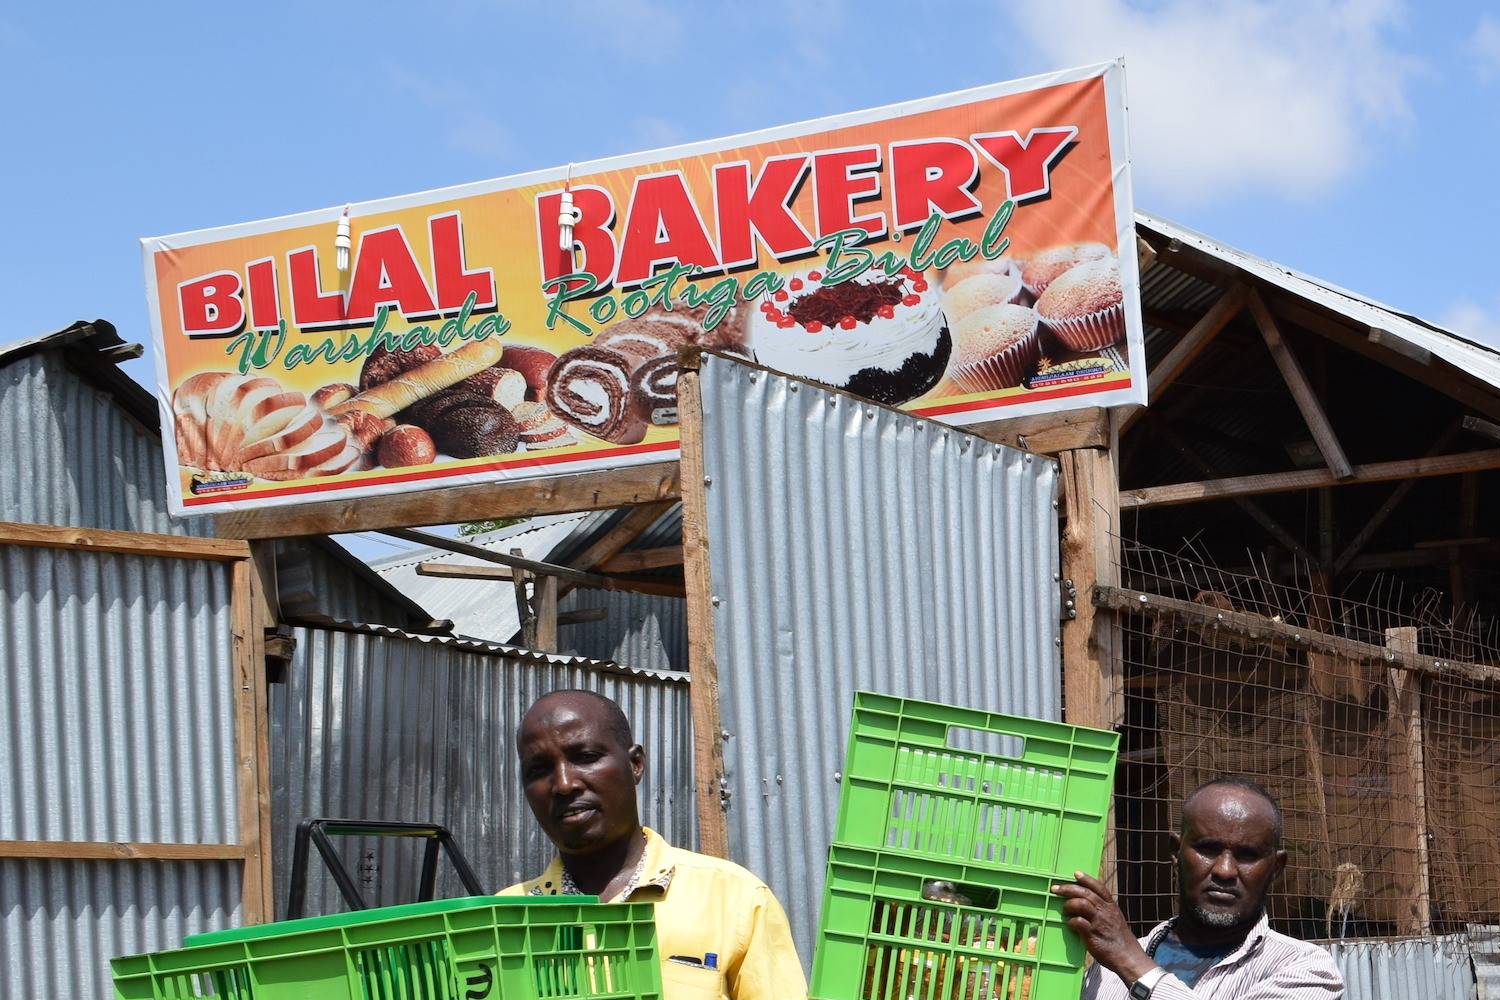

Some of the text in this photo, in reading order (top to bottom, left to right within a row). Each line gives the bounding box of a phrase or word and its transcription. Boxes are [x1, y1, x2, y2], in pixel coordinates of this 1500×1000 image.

[177, 126, 1080, 338] BILAL BAKERY
[225, 200, 1015, 375] Warshada Rootiga Bilal
